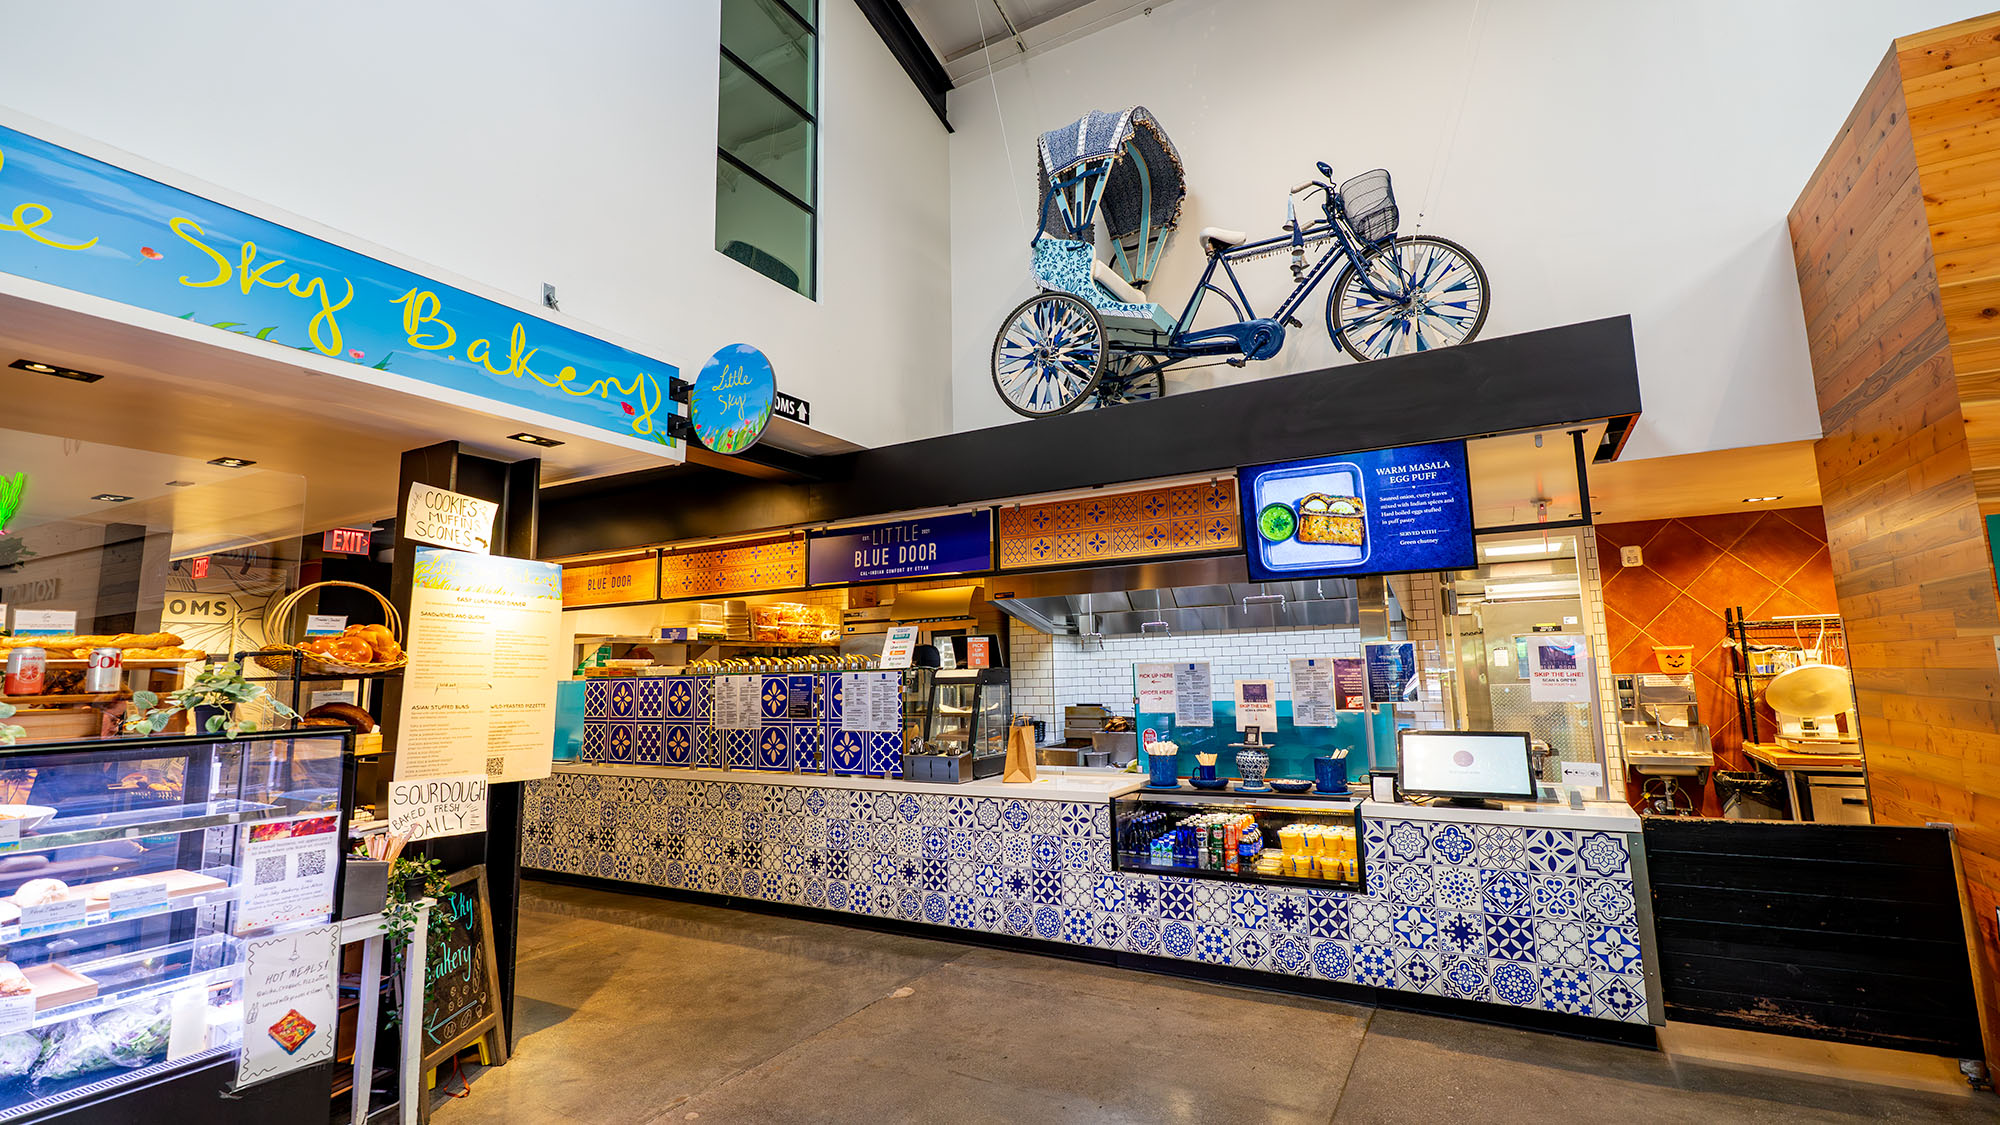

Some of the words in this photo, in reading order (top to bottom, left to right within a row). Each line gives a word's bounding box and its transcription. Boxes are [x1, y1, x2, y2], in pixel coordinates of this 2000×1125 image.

[0, 165, 99, 250] e
[169, 217, 354, 356] Sky
[390, 290, 662, 436] Bakery
[712, 364, 753, 391] Little
[718, 393, 746, 421] Sky
[1375, 465, 1407, 476] WARM
[1409, 460, 1451, 472] MASALA
[1389, 474, 1410, 484] EGG
[1411, 471, 1438, 482] PUFF
[425, 490, 478, 518] COOKIES
[414, 520, 472, 547] SCONES
[428, 511, 481, 533] MUFFINS
[1388, 518, 1399, 526] puff
[332, 528, 365, 553] EXIT
[872, 524, 918, 546] LITTLE
[854, 547, 890, 568] BLUE
[899, 542, 936, 564] DOOR
[588, 577, 606, 590] BLUE
[611, 574, 632, 588] DOOR
[169, 599, 227, 616] OMS
[394, 780, 486, 806] SOURDOUGH
[392, 807, 426, 831] BAKED
[434, 803, 460, 814] FRESH
[408, 811, 468, 840] DAILY
[265, 970, 287, 984] HOT
[289, 960, 328, 978] MEALS!
